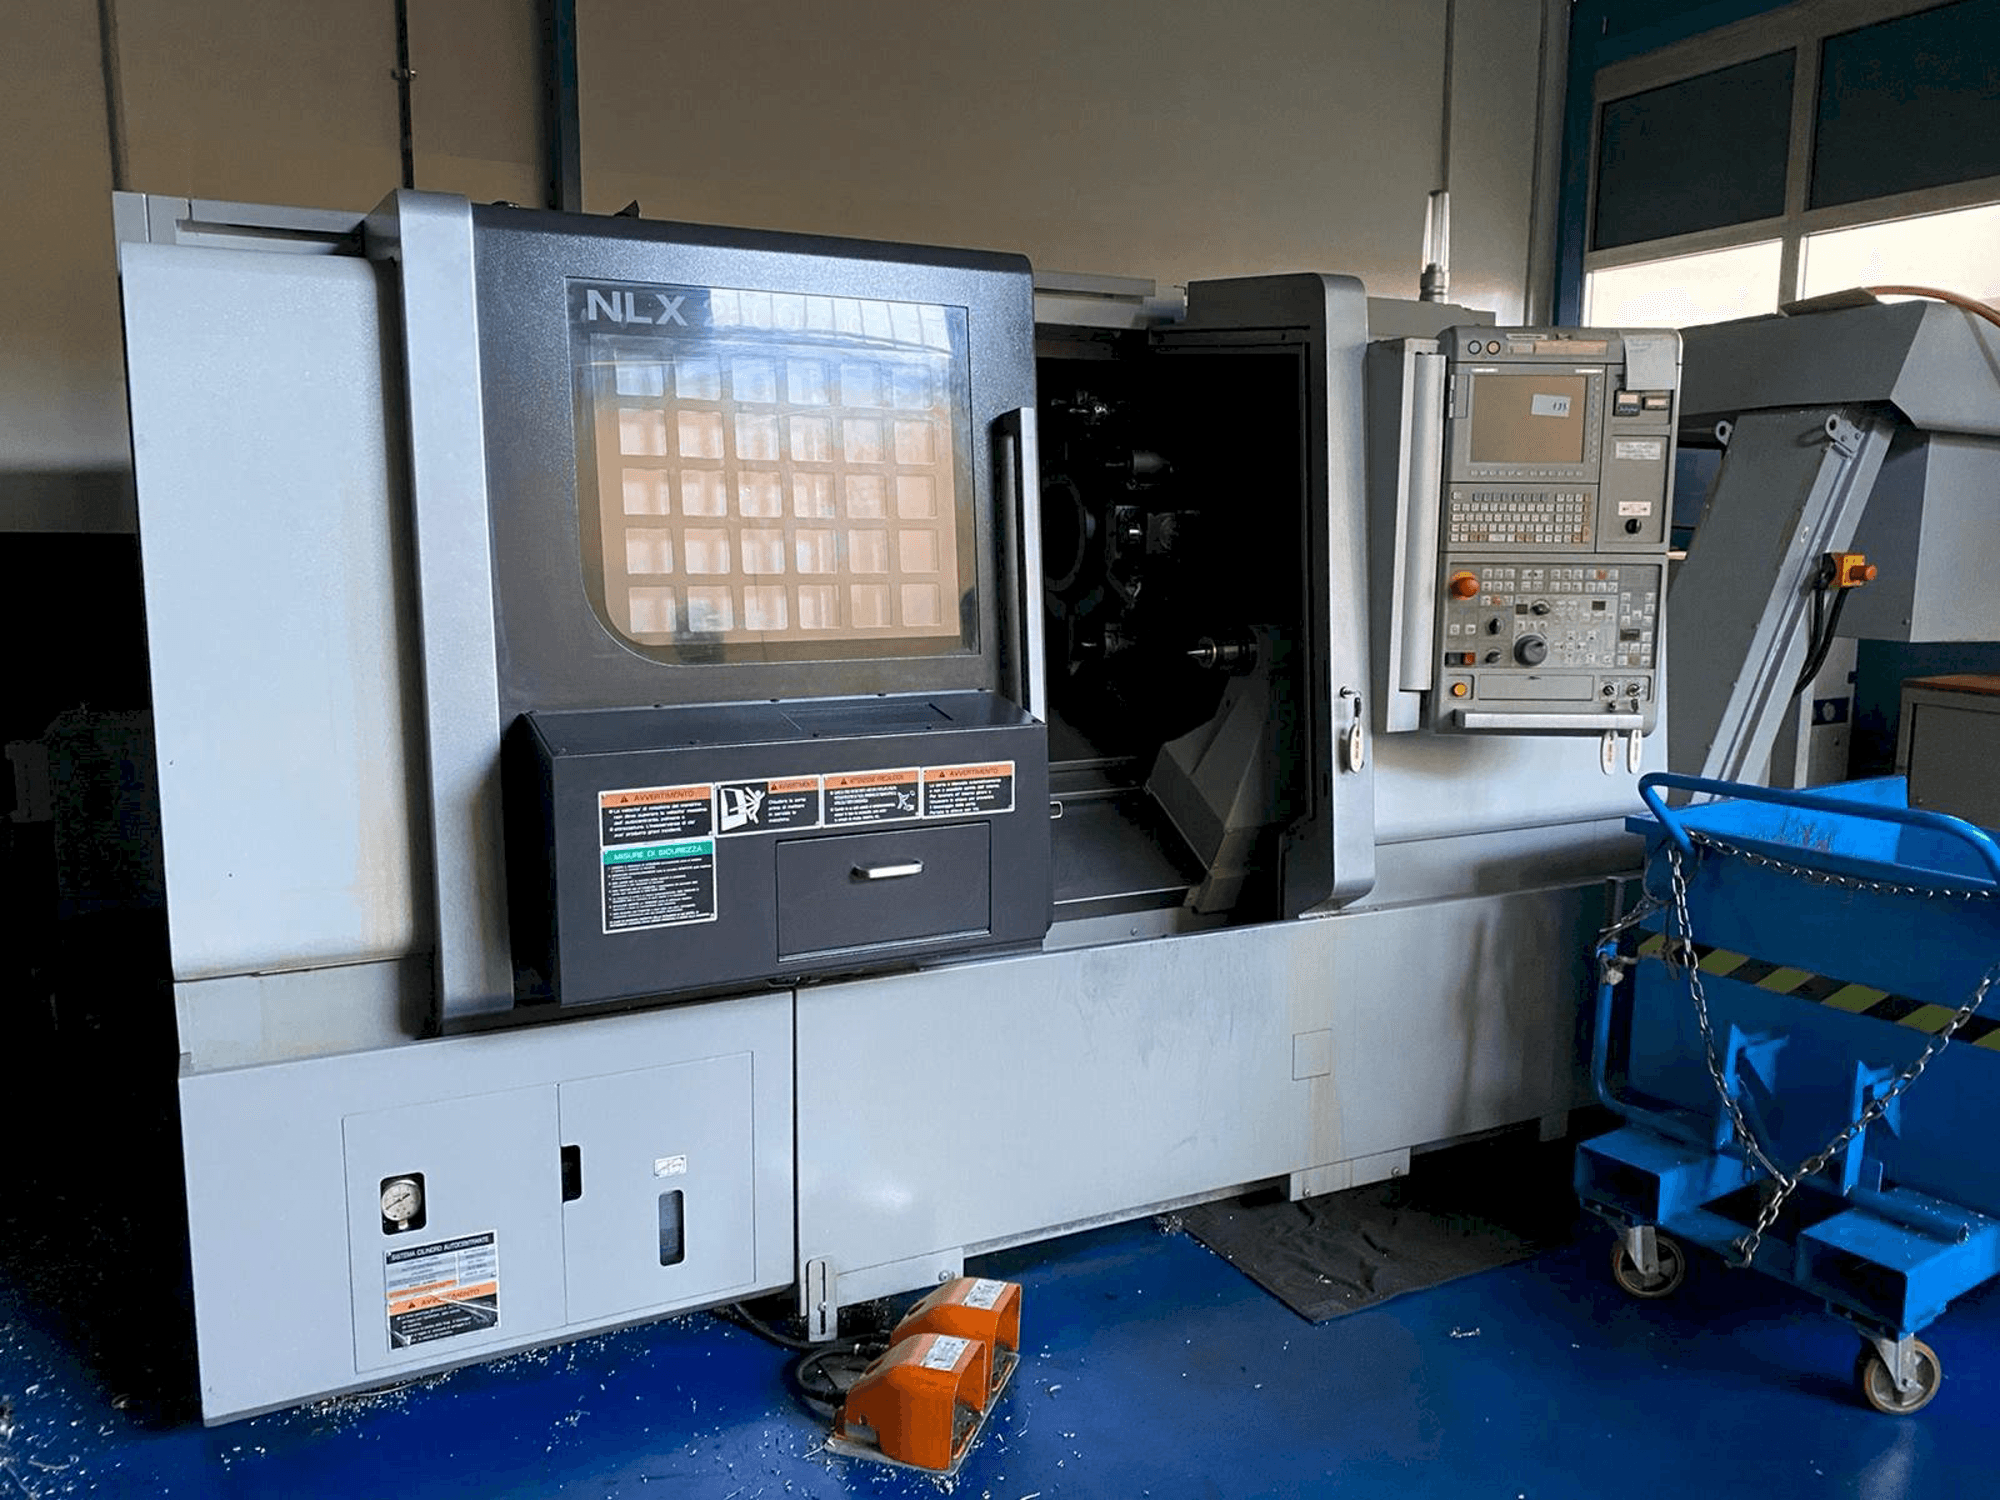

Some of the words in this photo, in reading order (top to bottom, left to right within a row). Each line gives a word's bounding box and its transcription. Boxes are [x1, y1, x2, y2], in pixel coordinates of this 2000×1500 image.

[586, 289, 688, 326] NLX
[634, 790, 695, 802] AVVERTIMENTO
[614, 850, 643, 860] MISURE
[647, 849, 655, 857] DI
[658, 845, 702, 856] SICUREZZA
[391, 1252, 415, 1261] SISTEMA
[416, 1245, 442, 1257] CILINDRO
